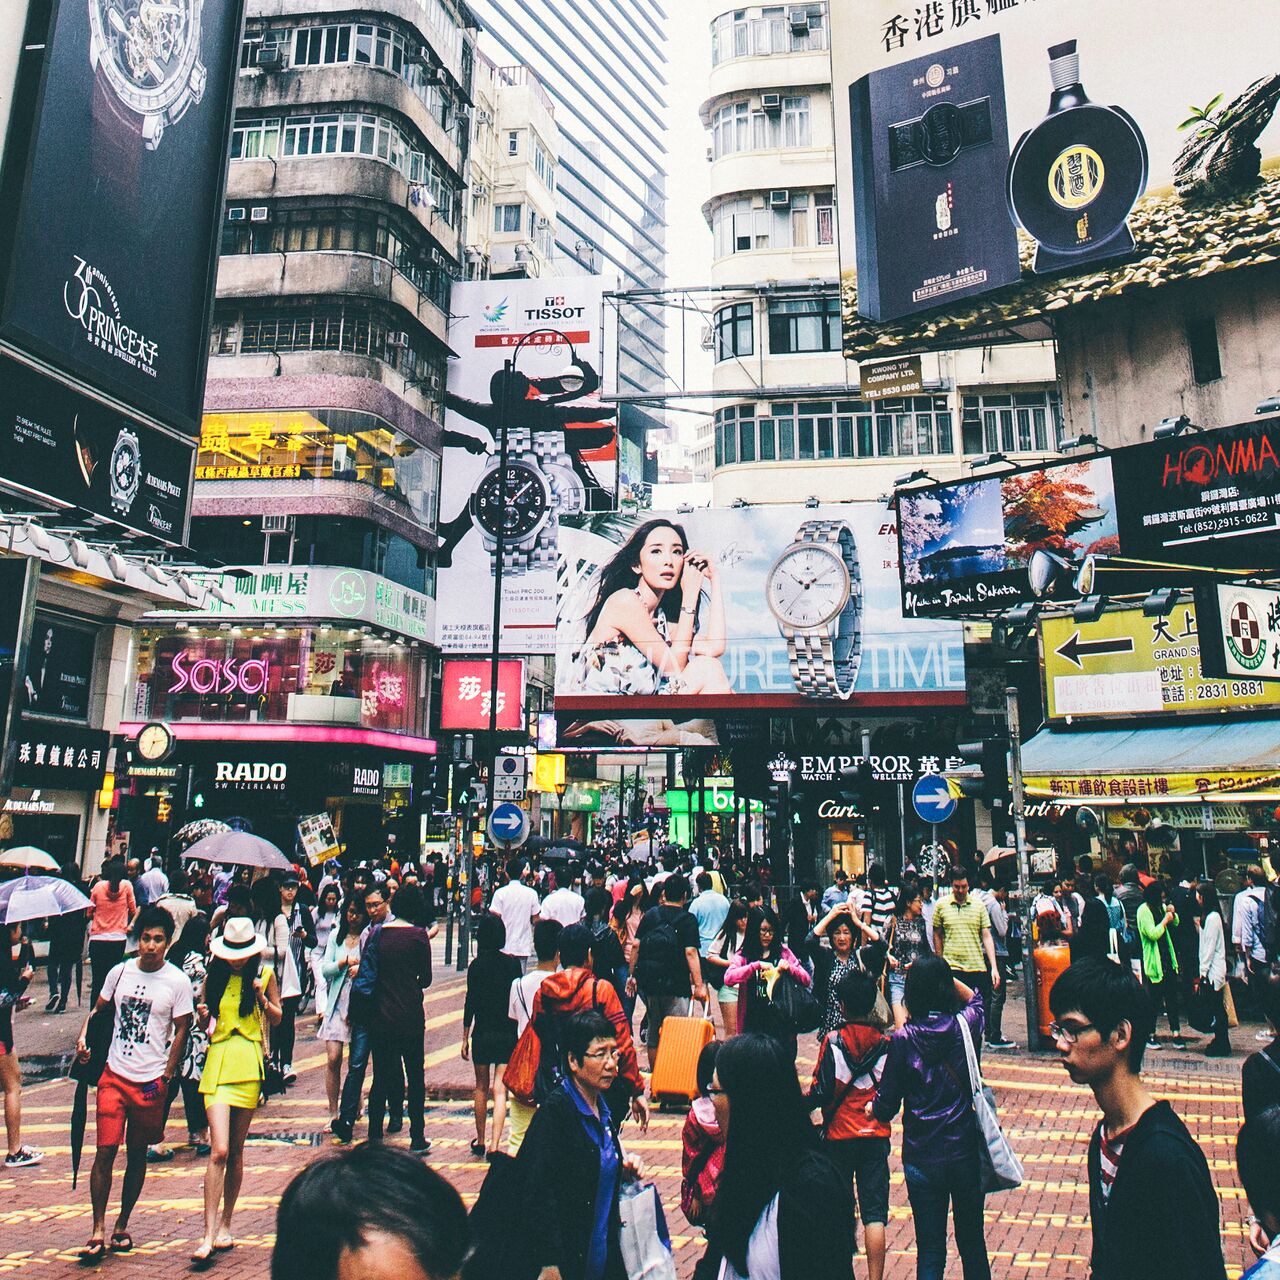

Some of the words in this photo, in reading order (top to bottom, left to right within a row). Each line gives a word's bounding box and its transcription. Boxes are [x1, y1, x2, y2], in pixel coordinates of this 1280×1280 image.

[91, 266, 122, 320] anniversary
[524, 306, 586, 321] TISSOT
[871, 364, 897, 375] KWONG
[897, 361, 910, 370] YIP
[867, 371, 900, 384] COMPANY
[900, 369, 916, 378] LTD.
[881, 385, 901, 396] 5530
[901, 382, 920, 392] 6086
[1162, 434, 1280, 488] HONMA
[145, 471, 168, 493] AUDEMARS
[1178, 524, 1193, 535] Tel:
[1193, 521, 1217, 534] (852)
[251, 599, 307, 615] MESS
[1153, 649, 1187, 661] GRAND
[1189, 647, 1201, 659] SH
[863, 641, 966, 689] TIME
[1197, 683, 1228, 699] 2831
[1232, 680, 1265, 696] 9881
[214, 761, 288, 783] RADO
[353, 767, 380, 787] RADO
[801, 773, 833, 781] WATCH
[512, 777, 519, 786] 7
[512, 790, 522, 800] 12
[2, 798, 40, 811] AUDEMARS
